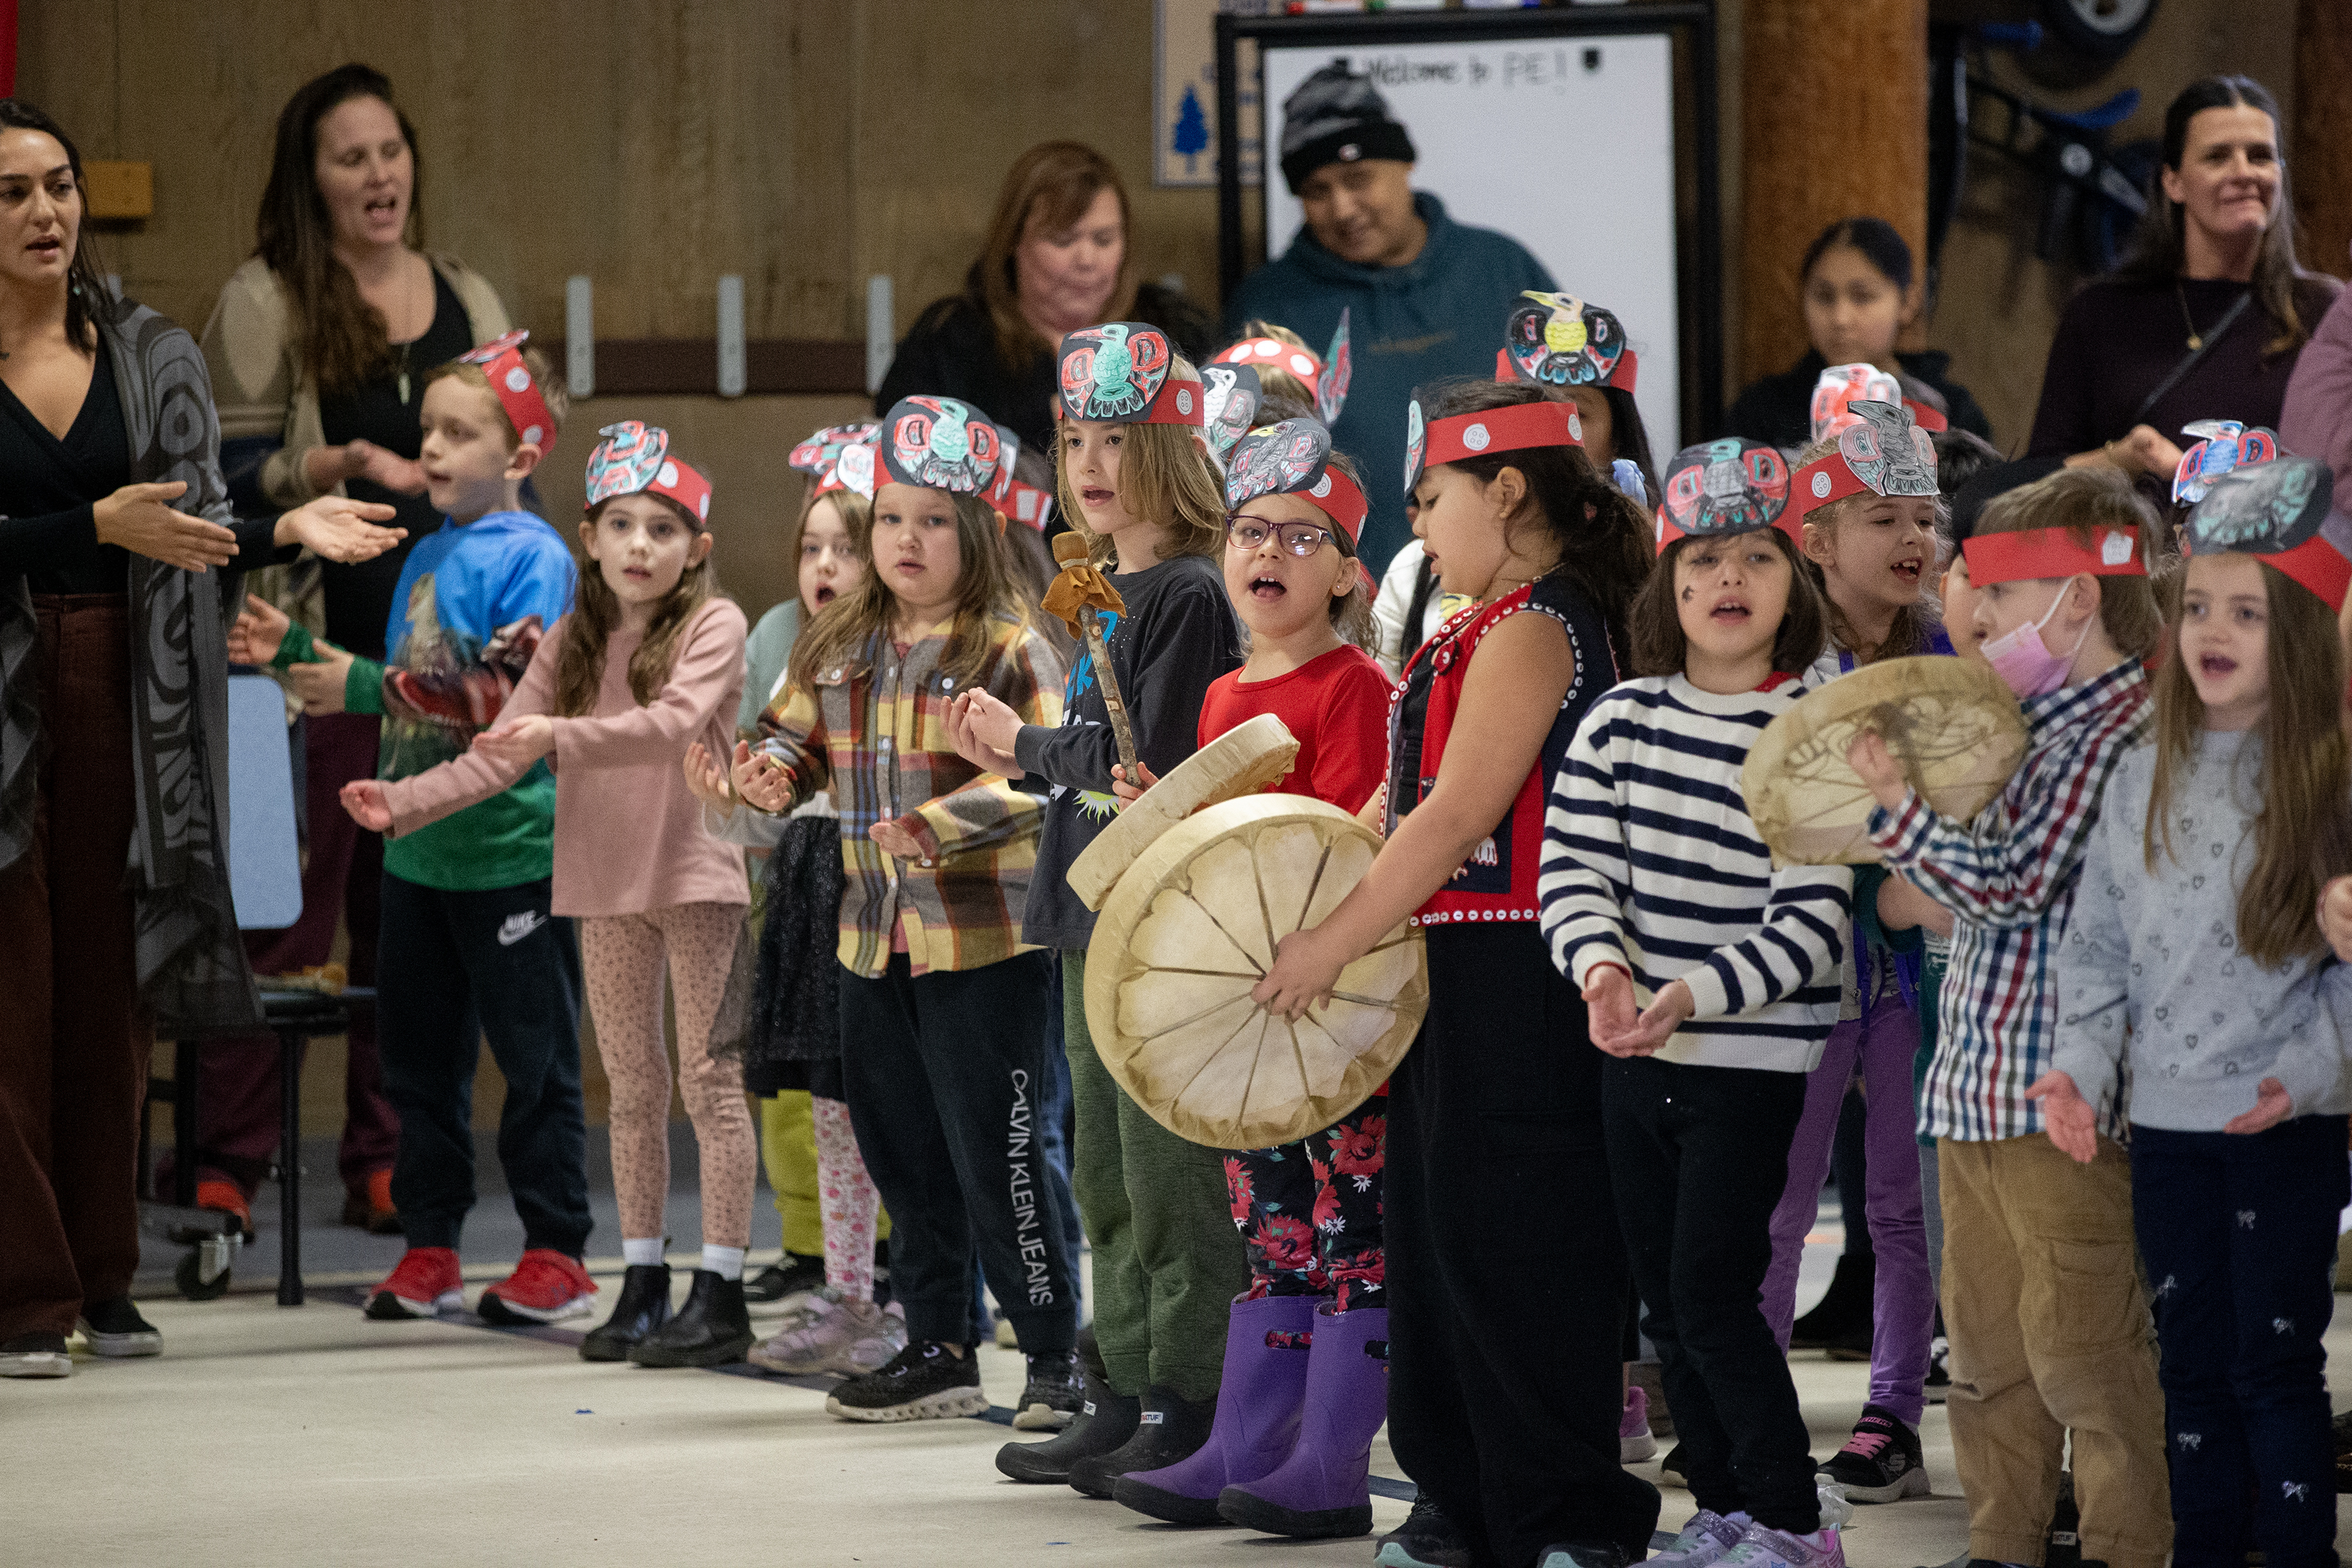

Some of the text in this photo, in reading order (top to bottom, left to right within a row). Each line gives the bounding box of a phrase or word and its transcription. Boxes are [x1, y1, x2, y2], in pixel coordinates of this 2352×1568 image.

[1007, 1069, 1053, 1306] CALVIN KLEIN JEANS
